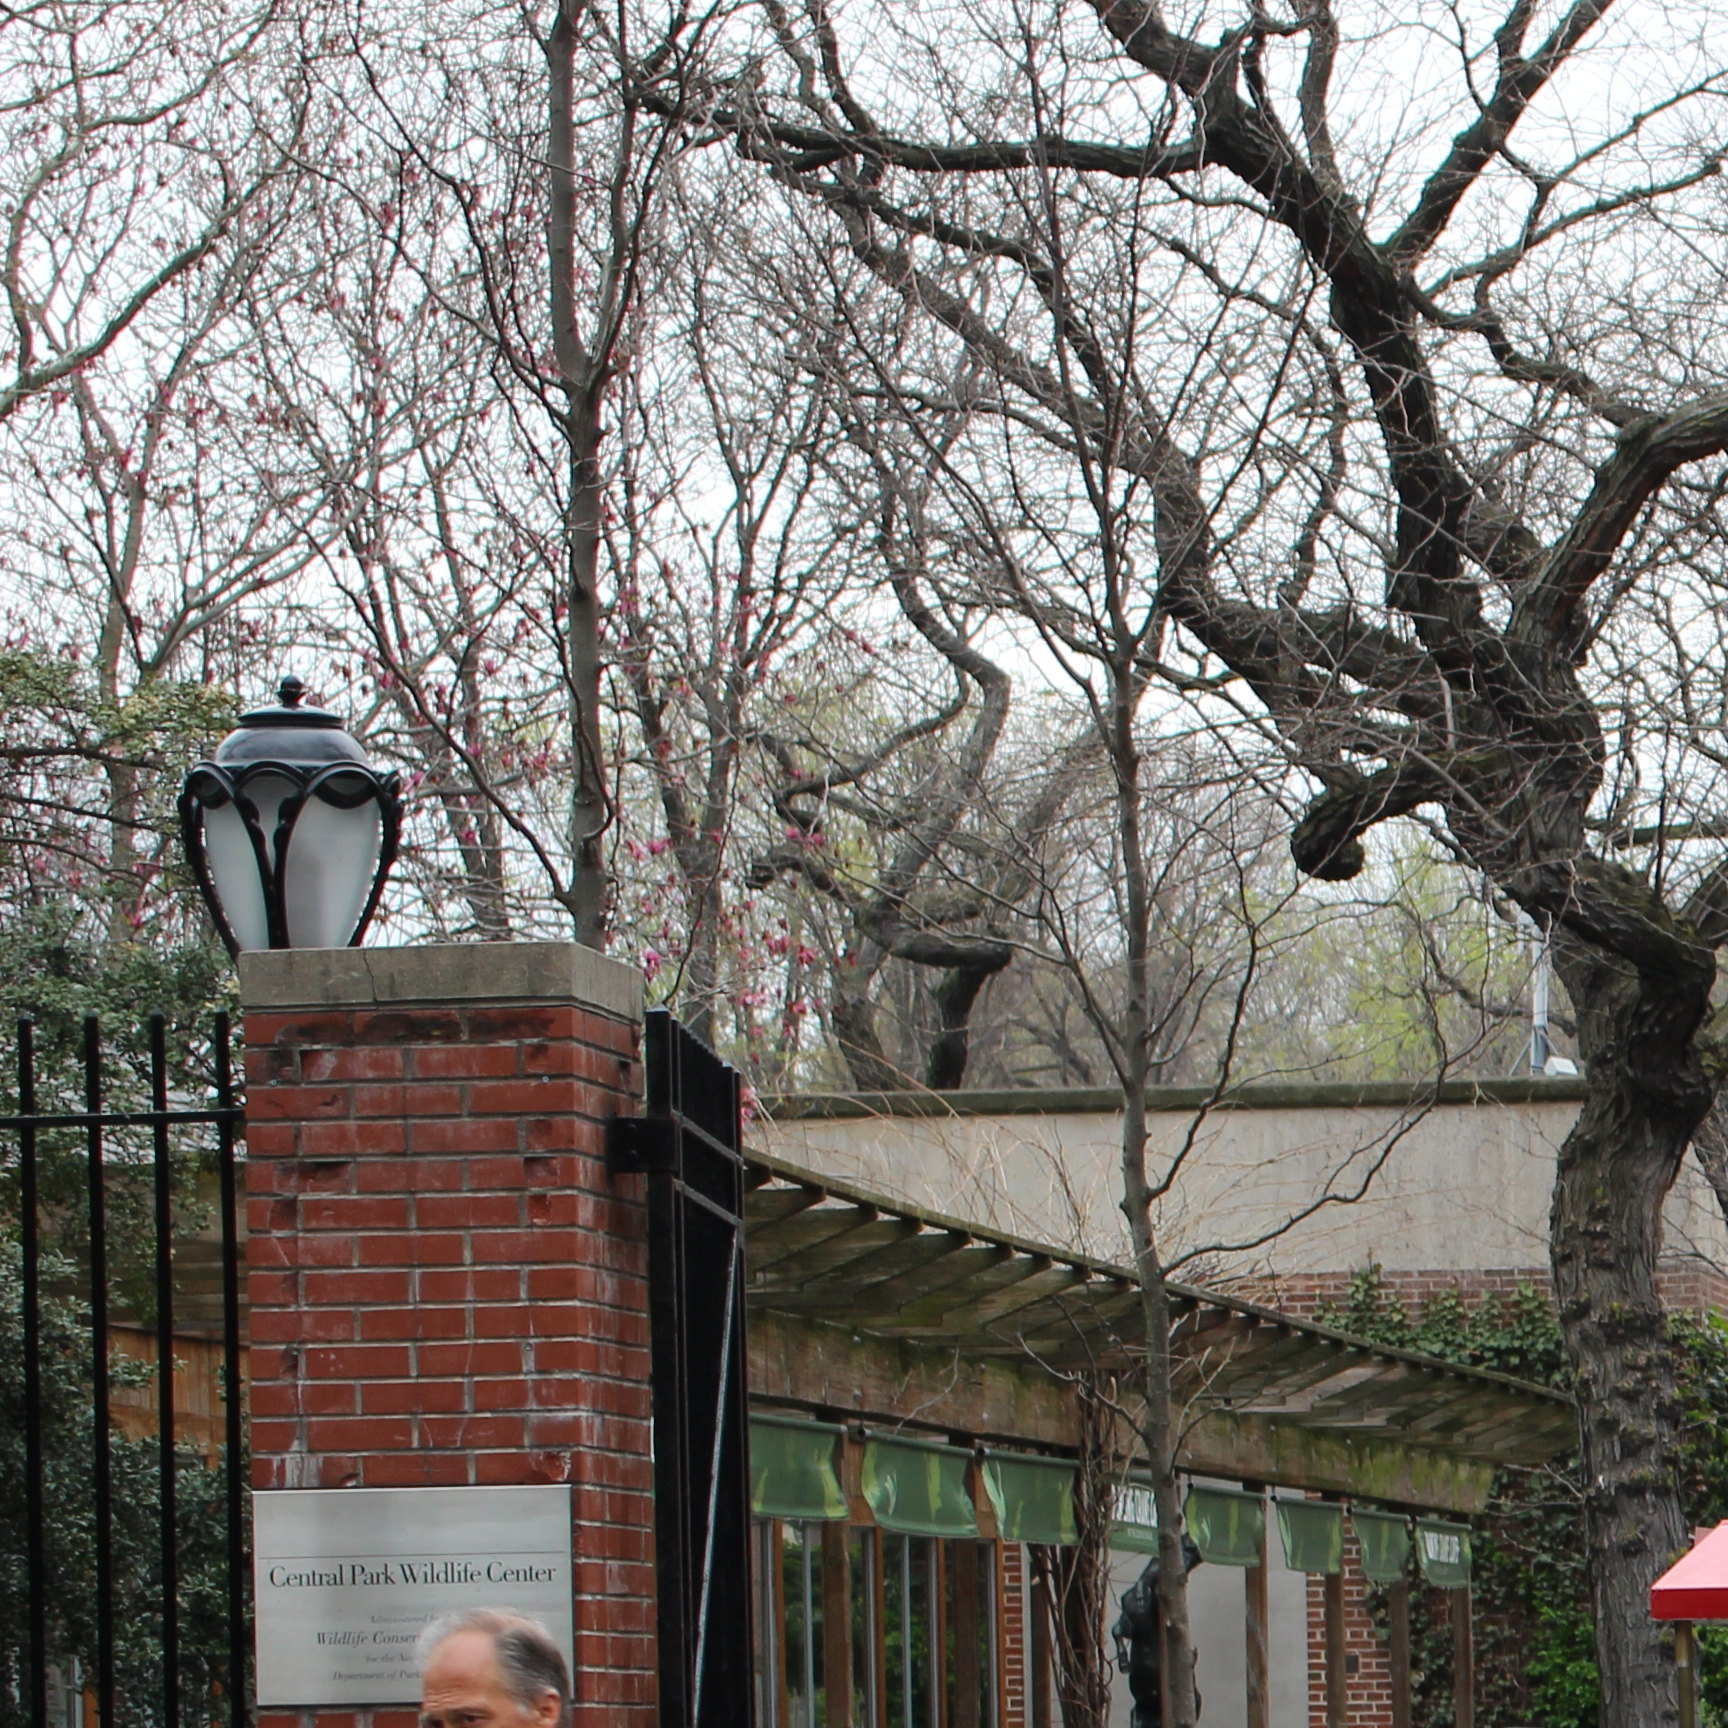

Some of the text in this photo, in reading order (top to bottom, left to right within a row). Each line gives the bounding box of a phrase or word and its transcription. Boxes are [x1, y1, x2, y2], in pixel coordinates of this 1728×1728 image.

[269, 1560, 557, 1588] Central Park Wildlife Center
[317, 1630, 421, 1647] Wildlife Conser
